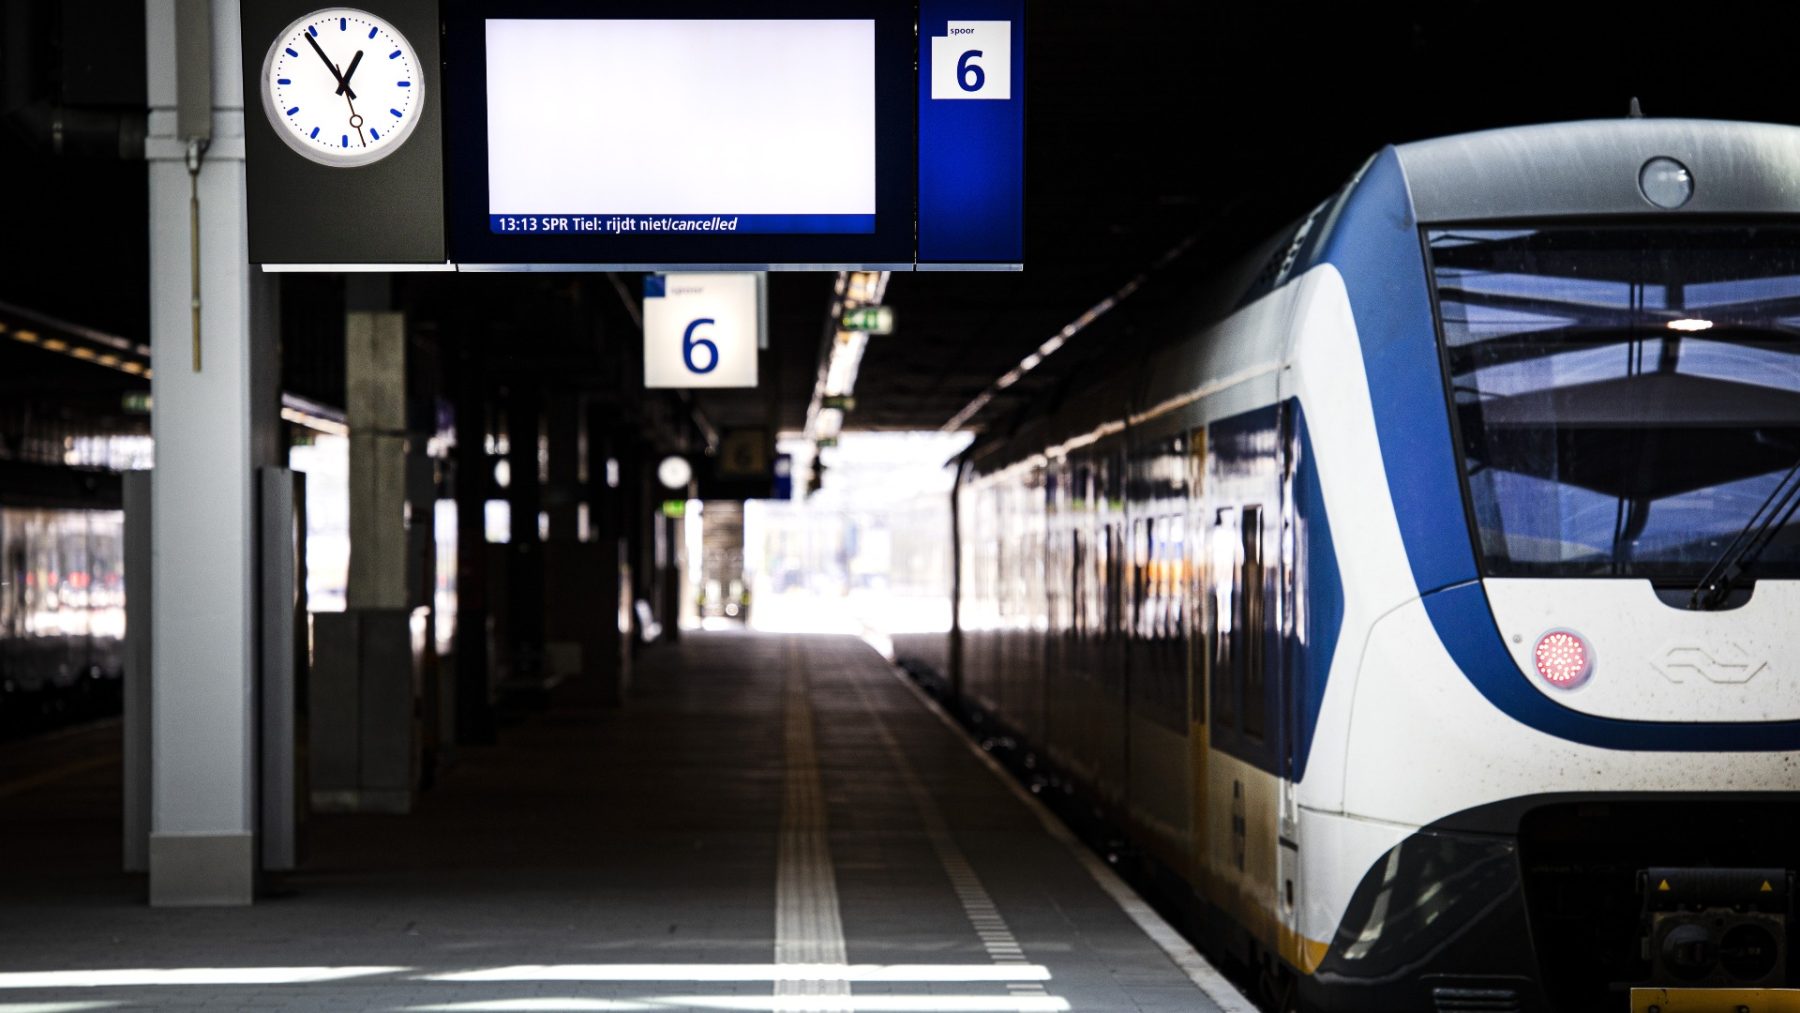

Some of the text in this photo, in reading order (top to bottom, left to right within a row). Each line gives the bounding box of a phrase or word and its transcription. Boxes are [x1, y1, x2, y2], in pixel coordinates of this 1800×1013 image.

[950, 27, 974, 35] spoor
[957, 49, 985, 92] 6
[499, 217, 738, 234] 13:13 SPR Tiel: rijdt niet/cancelled
[682, 318, 719, 374] 6
